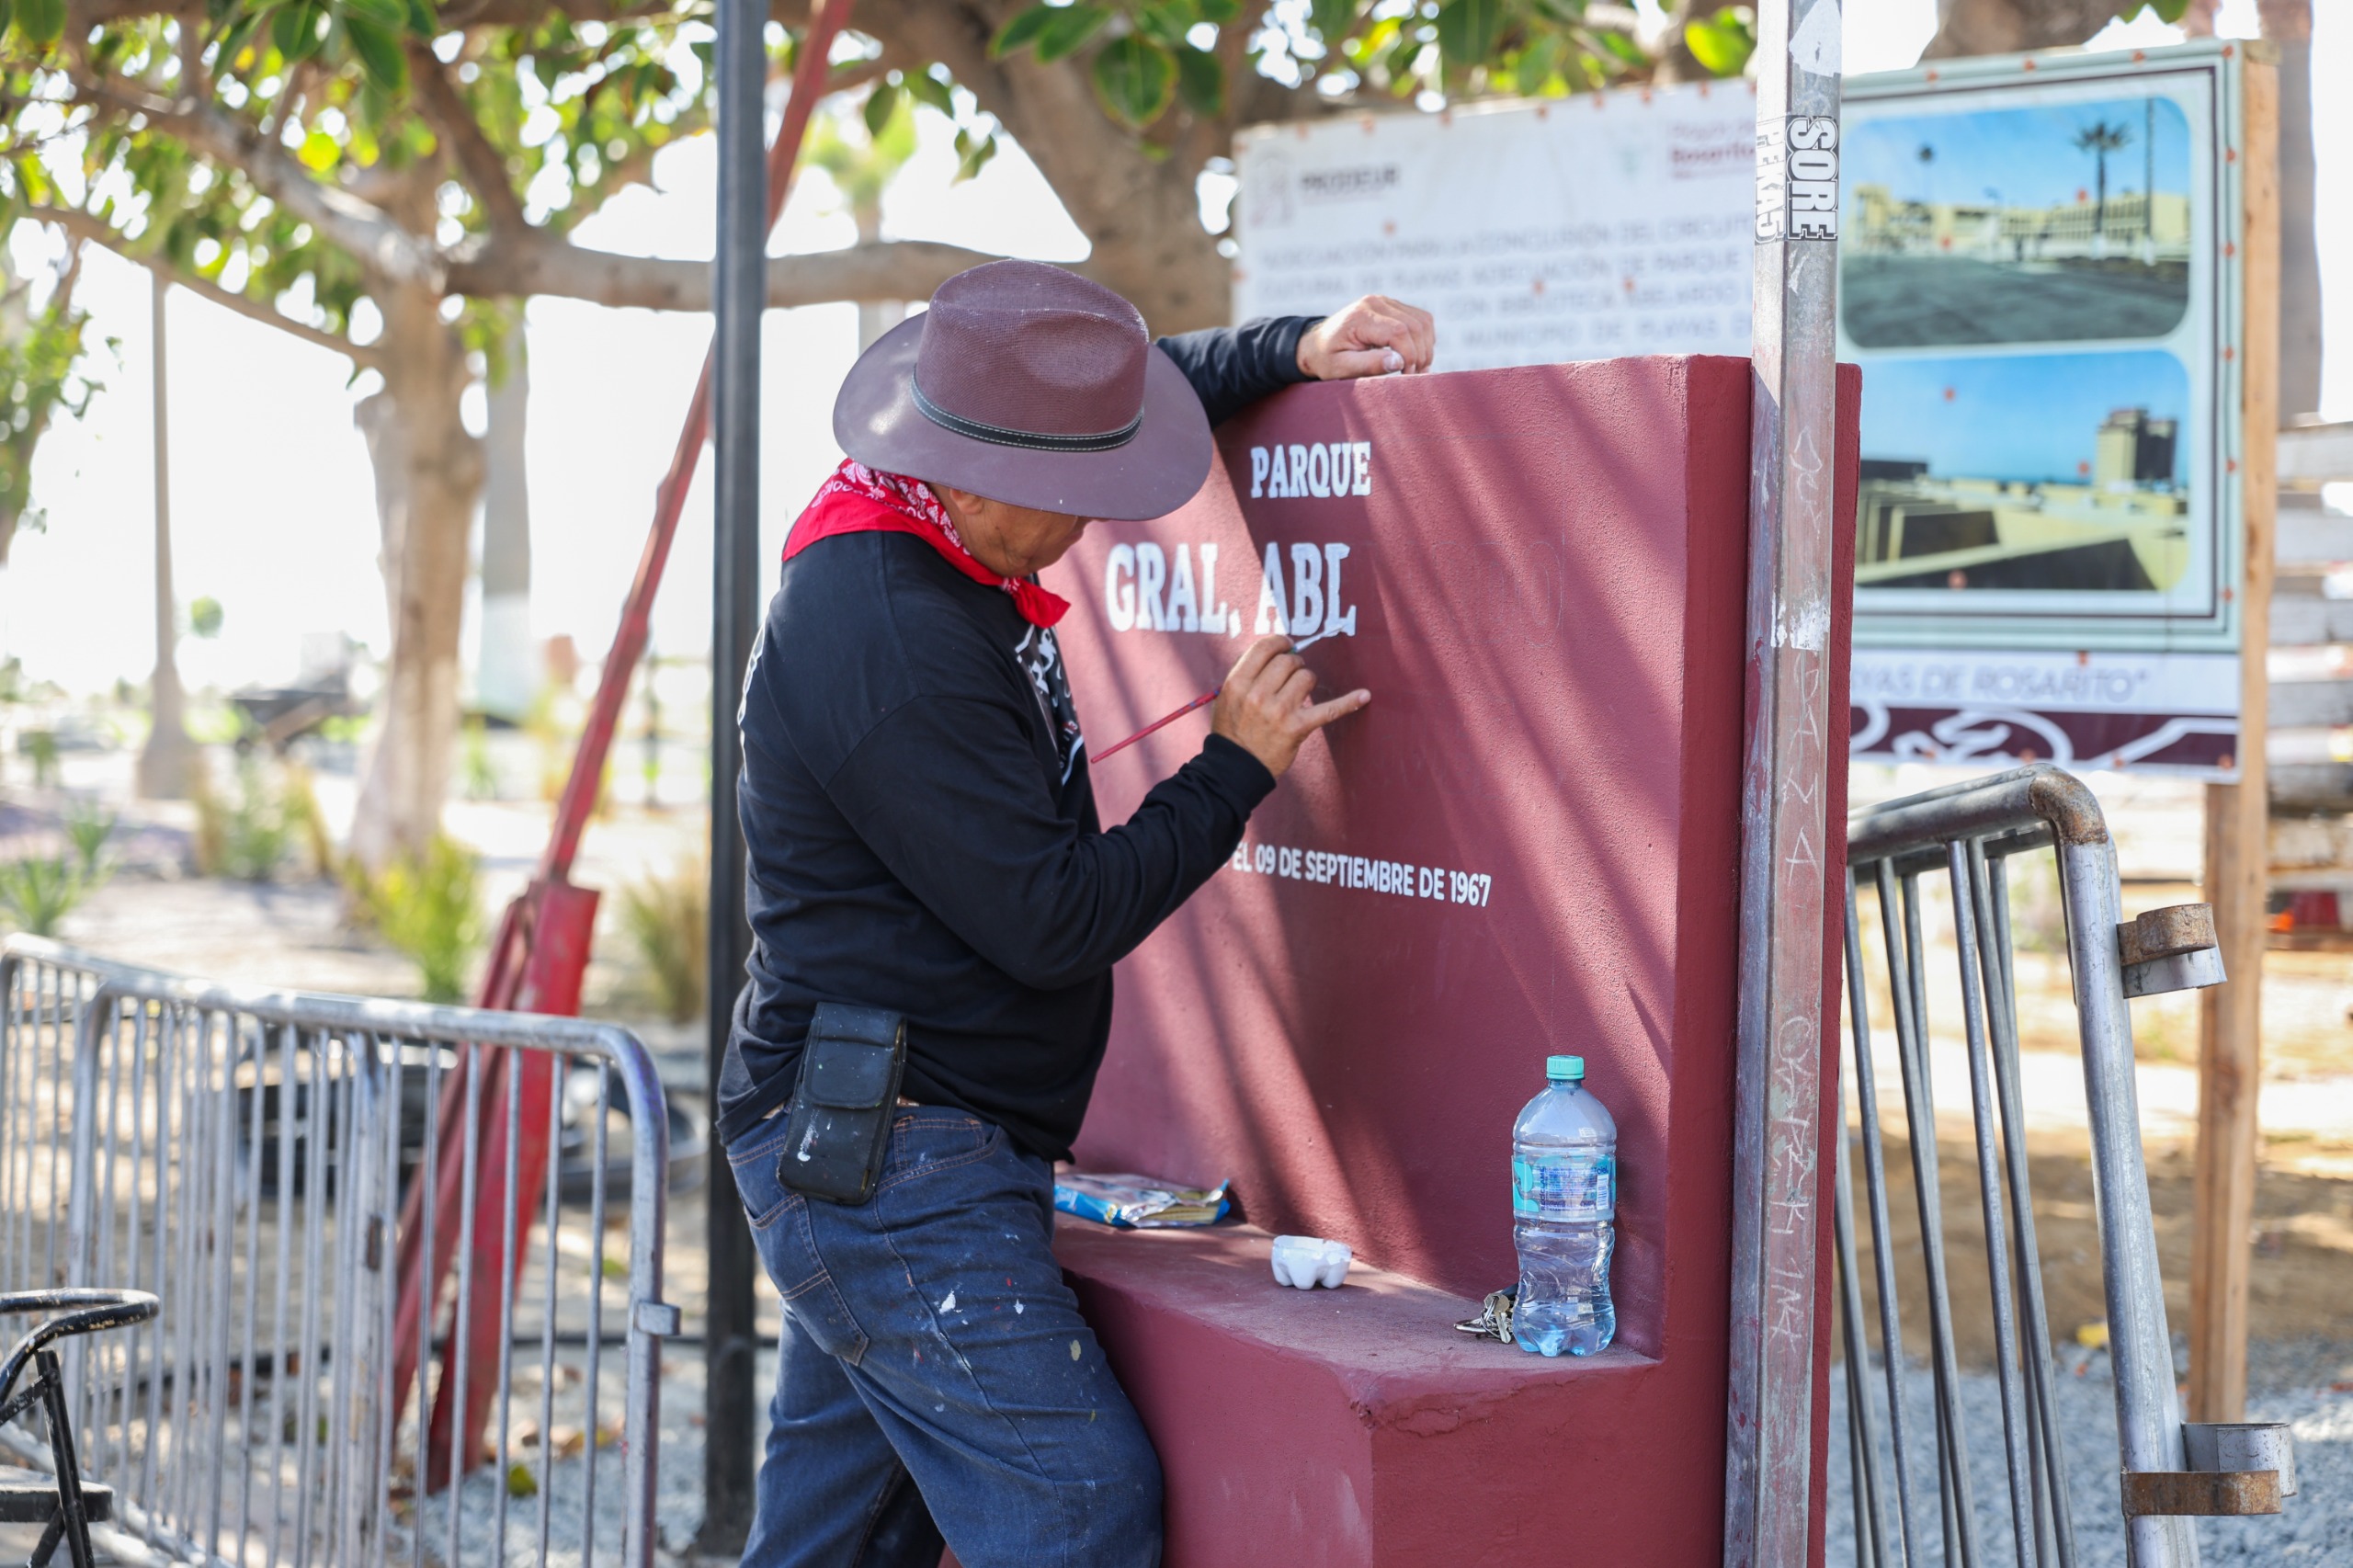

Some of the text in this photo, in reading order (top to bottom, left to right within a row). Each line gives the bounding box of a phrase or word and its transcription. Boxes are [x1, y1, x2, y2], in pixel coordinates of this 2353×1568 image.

[1786, 117, 1838, 240] SORE
[1250, 441, 1372, 499] PARQUE
[1233, 842, 1493, 908] EL 09 DE SEPTIEMBRE DE 1967
